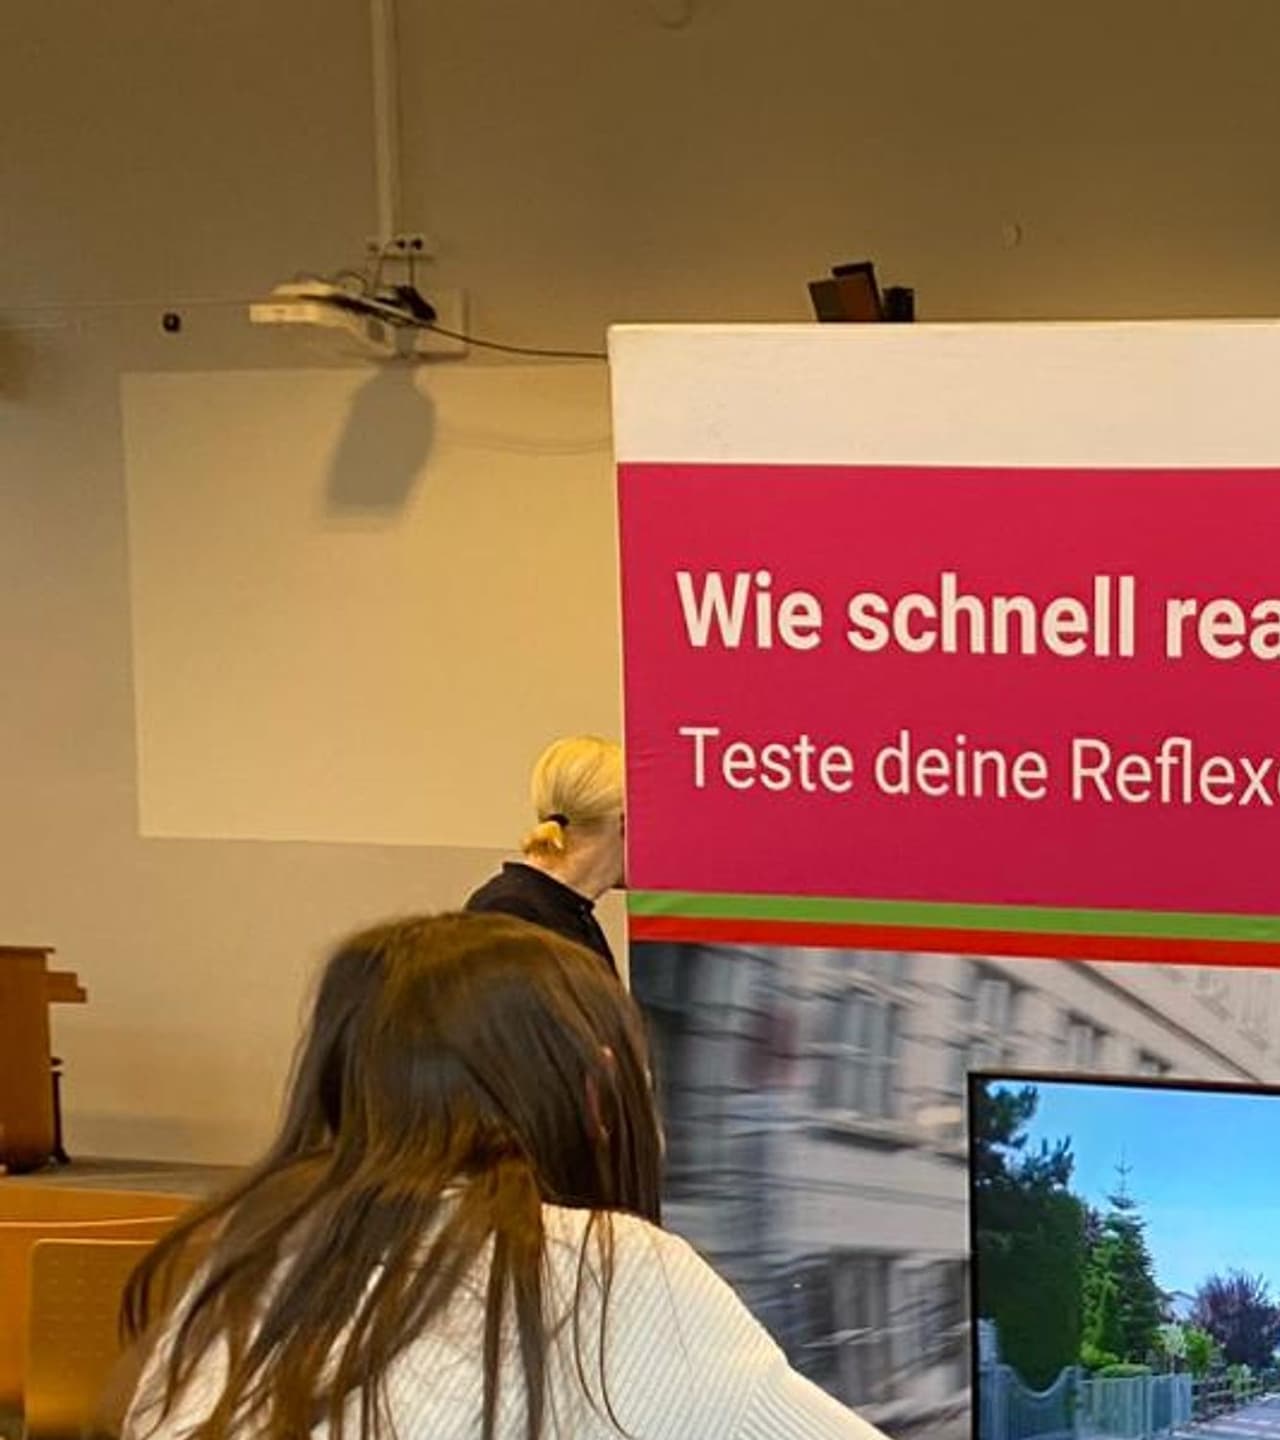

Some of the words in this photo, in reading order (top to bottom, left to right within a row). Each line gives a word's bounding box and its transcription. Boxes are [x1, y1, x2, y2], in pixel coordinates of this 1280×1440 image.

[676, 570, 822, 650] Wie
[847, 572, 1135, 657] schnell
[679, 727, 854, 792] Teste
[875, 730, 1048, 799] deine
